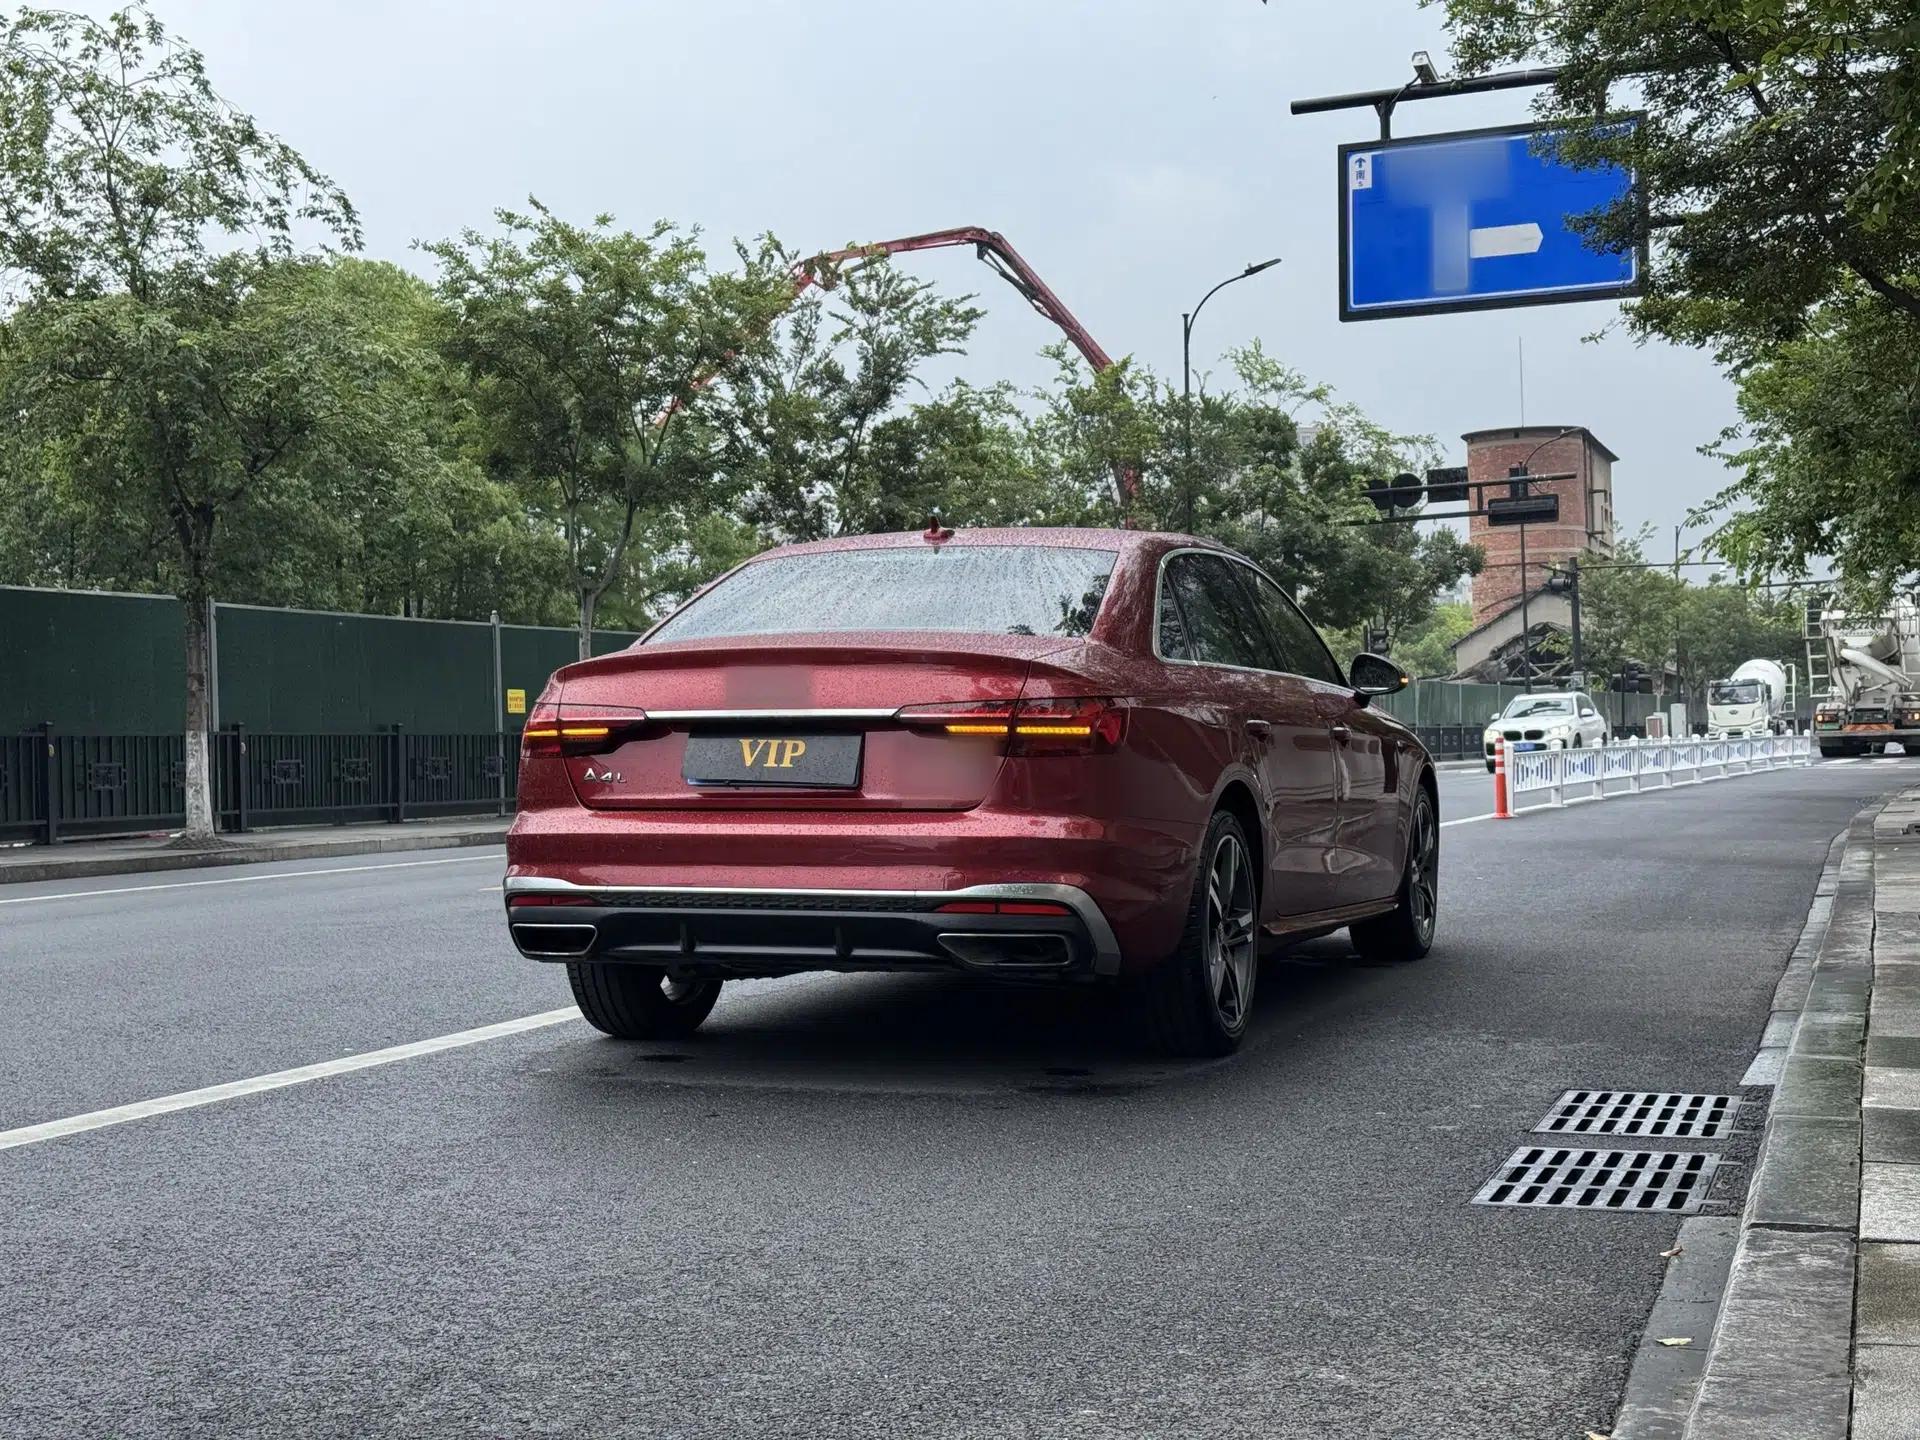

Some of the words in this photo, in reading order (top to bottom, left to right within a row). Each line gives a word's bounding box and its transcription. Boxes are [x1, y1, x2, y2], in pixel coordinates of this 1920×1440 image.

[1355, 170, 1366, 181] 南
[738, 738, 806, 768] VIP
[583, 767, 628, 784] A4L
